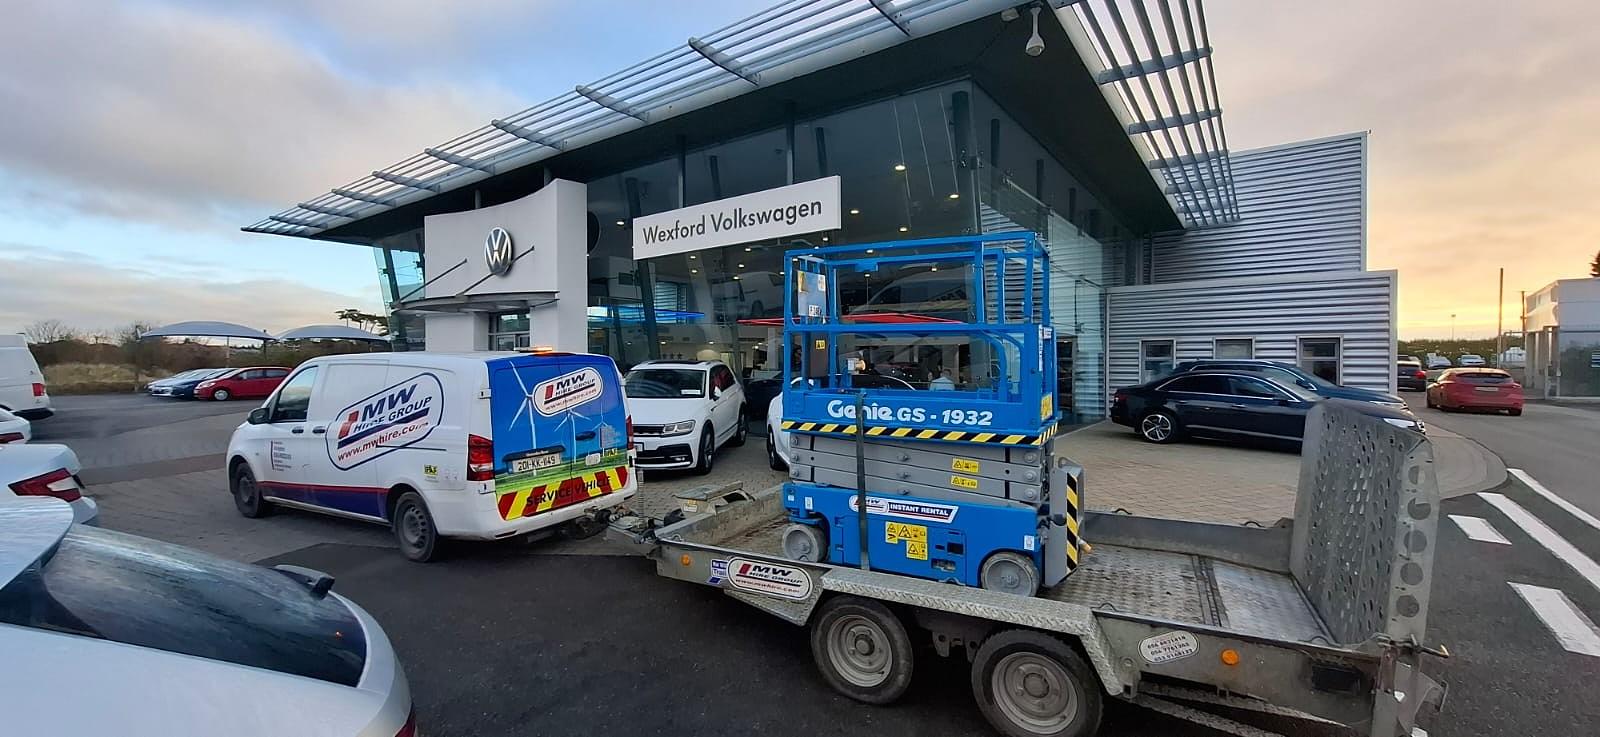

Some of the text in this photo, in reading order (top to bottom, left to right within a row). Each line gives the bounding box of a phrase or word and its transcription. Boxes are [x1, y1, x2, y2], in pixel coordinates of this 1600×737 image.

[643, 198, 823, 245] Wexford Volkswagen
[556, 373, 586, 390] MW
[361, 383, 418, 422] MW
[388, 396, 433, 422] GROUP
[827, 399, 893, 421] Genie
[897, 407, 926, 423] GS
[942, 409, 993, 426] 1932
[526, 476, 611, 505] SERVICE VEHICLE
[890, 503, 949, 516] INSTANT RENTAL
[752, 565, 792, 577] MW
